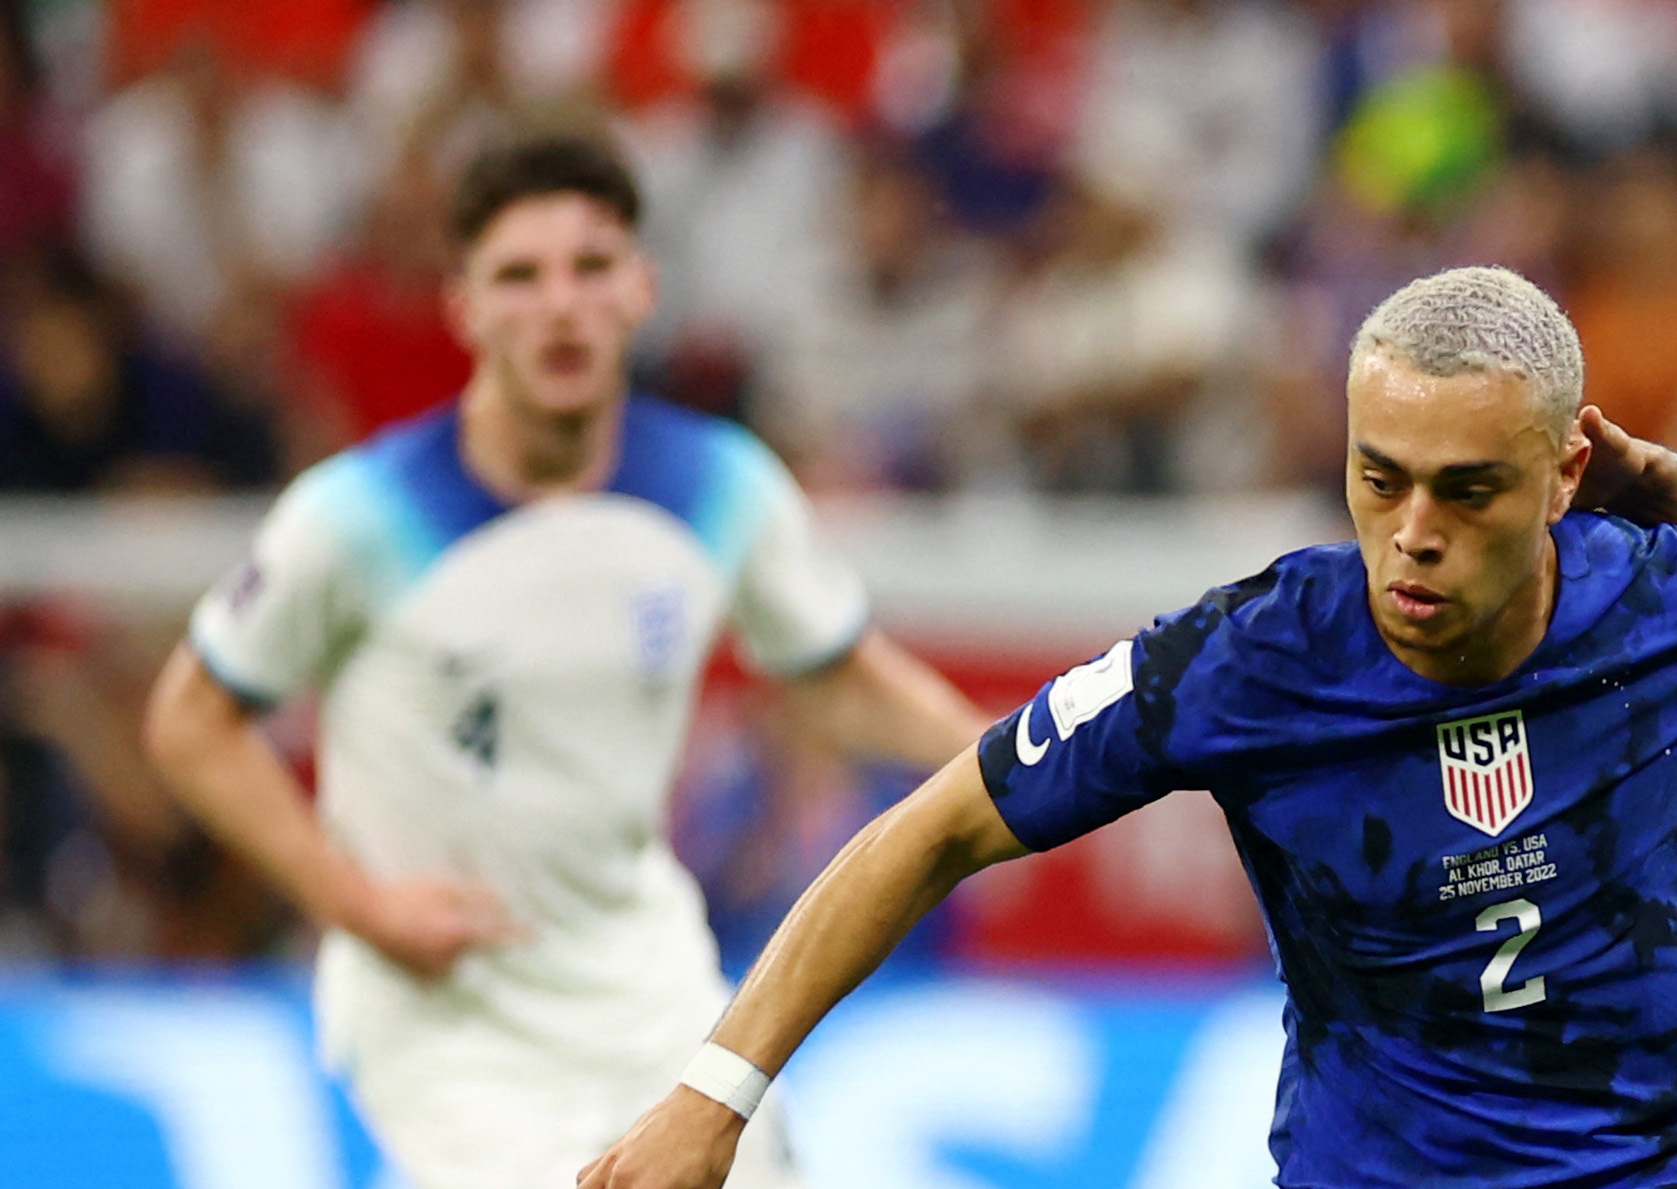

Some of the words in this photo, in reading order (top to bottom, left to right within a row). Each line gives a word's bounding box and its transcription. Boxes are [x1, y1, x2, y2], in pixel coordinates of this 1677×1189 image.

[1442, 716, 1520, 767] USA
[1442, 845, 1499, 870] ENGLAND
[1523, 833, 1548, 852] USA
[1448, 868, 1465, 883] AL
[1505, 850, 1545, 872] QATAR
[1439, 884, 1456, 901] 25
[1458, 871, 1524, 897] NOVEMBER
[1525, 862, 1558, 884] 2022
[1475, 898, 1547, 1013] 2
